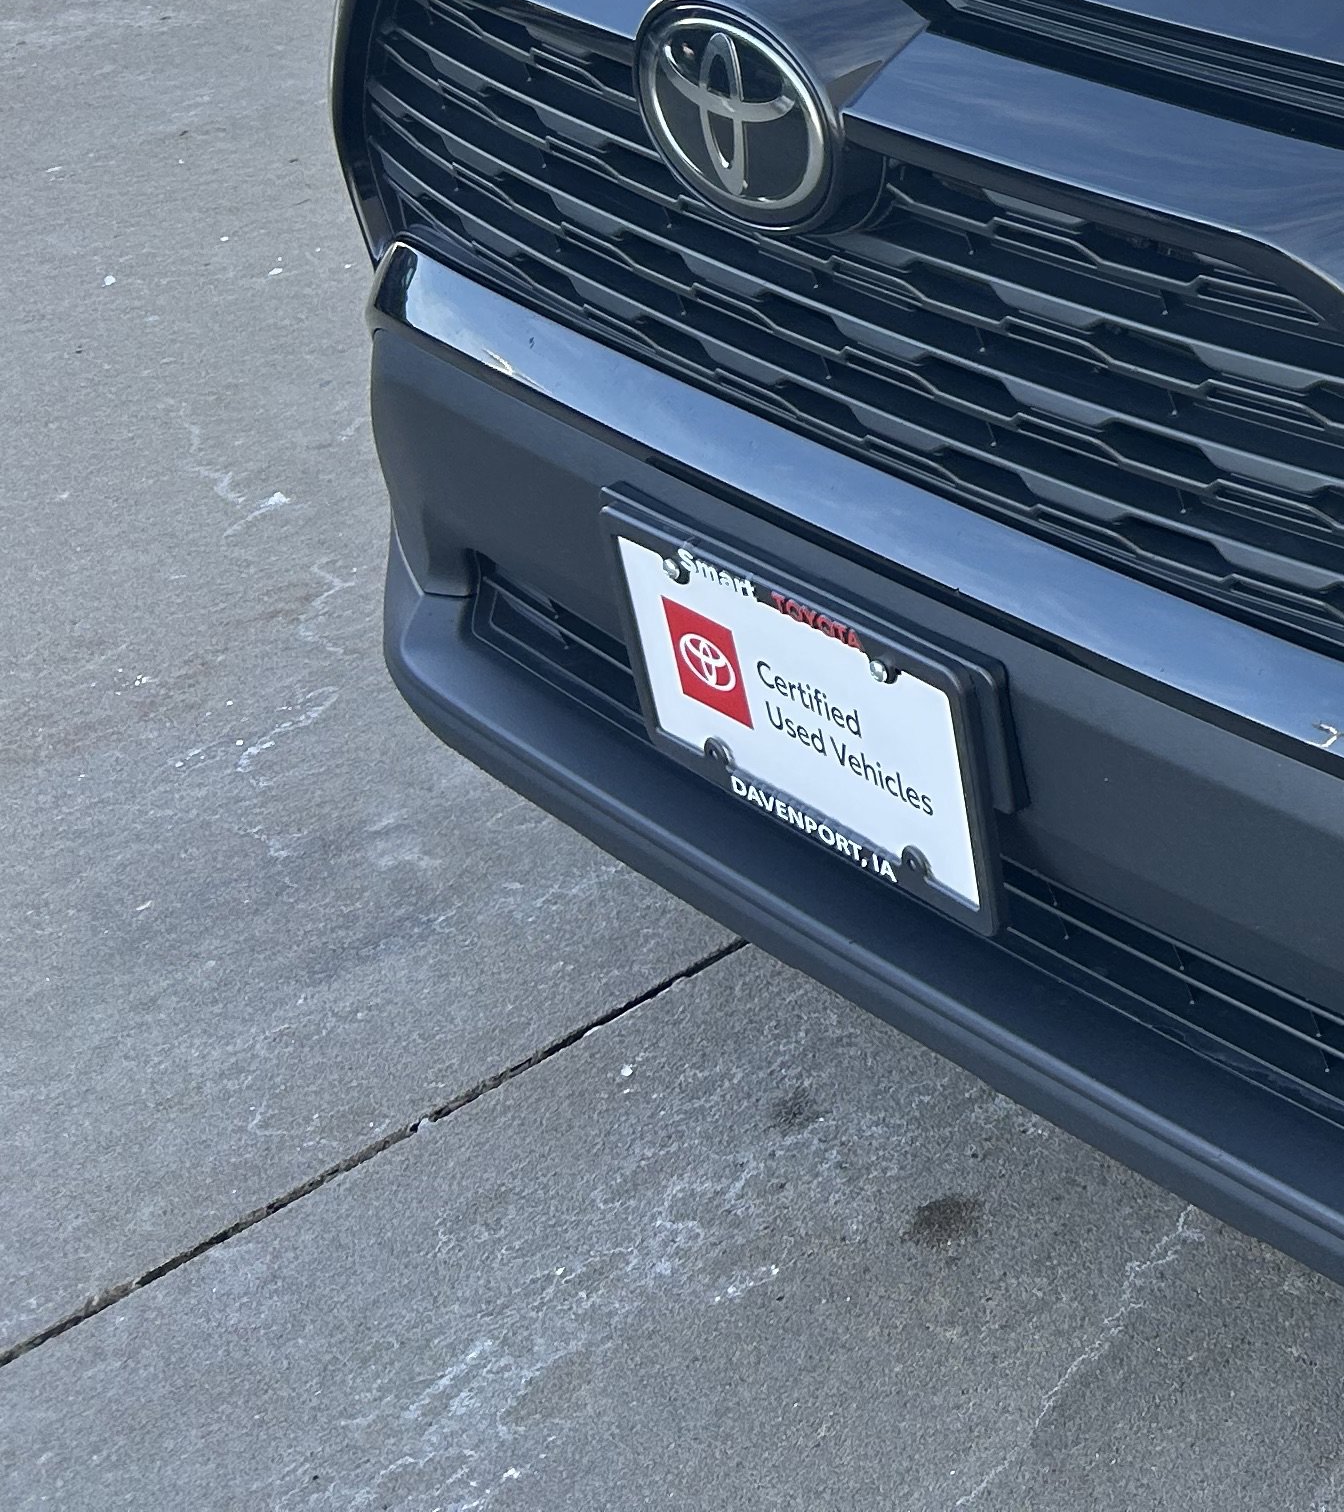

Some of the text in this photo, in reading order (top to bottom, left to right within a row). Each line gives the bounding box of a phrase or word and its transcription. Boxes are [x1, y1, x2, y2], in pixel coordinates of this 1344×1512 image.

[677, 547, 864, 650] Smart TOYOTA
[757, 660, 862, 738] Certified
[765, 701, 933, 816] Used Vehicles
[730, 774, 898, 883] DAVENPORT, IA
